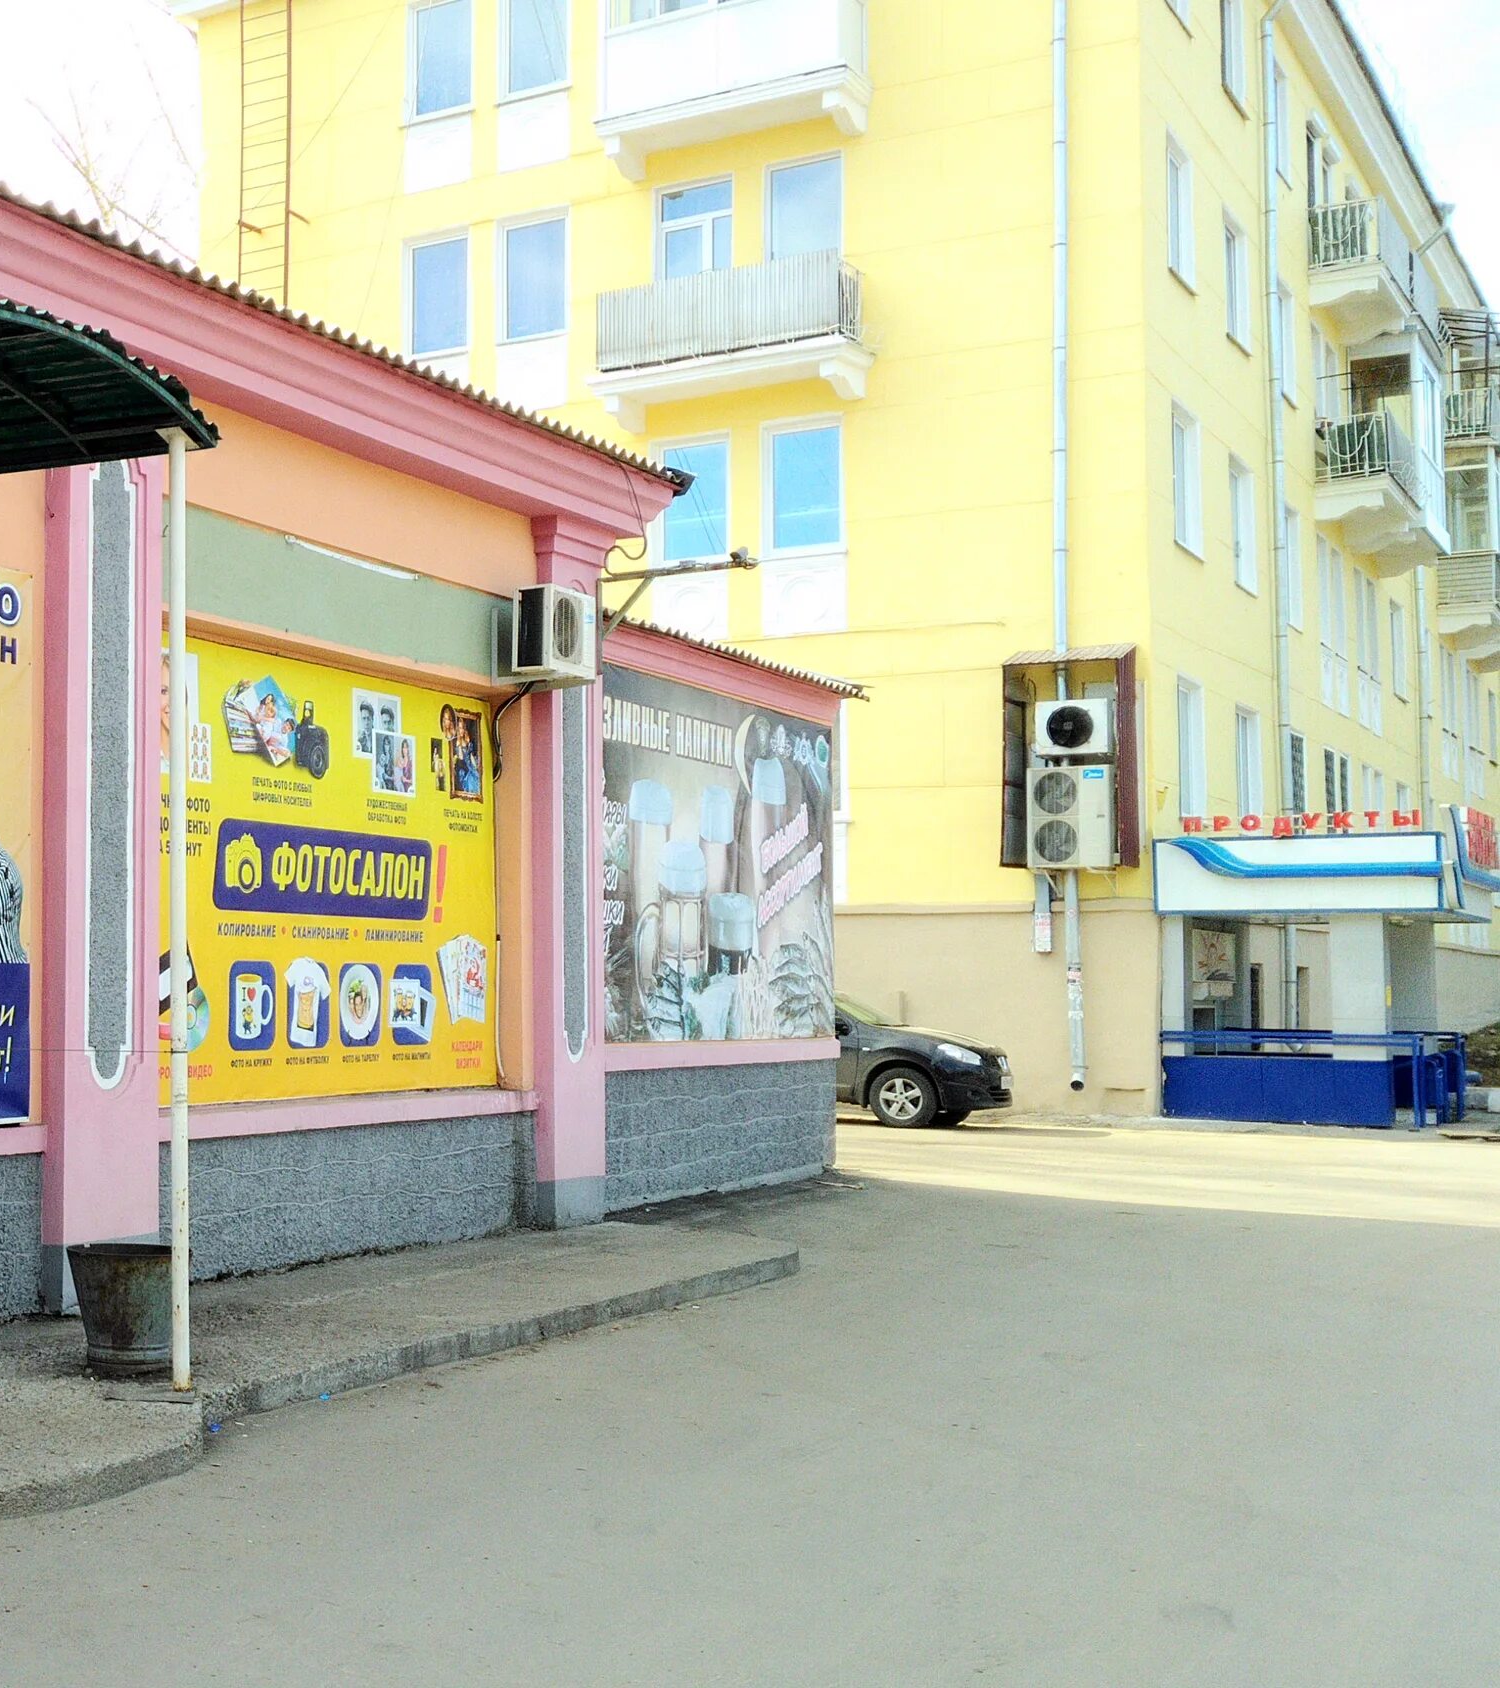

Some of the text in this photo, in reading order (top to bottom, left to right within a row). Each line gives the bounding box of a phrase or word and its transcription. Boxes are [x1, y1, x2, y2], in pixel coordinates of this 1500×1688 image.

[676, 714, 733, 768] НАПИТКИ
[273, 780, 288, 791] ФОТО
[186, 796, 211, 813] ФОТО
[1182, 809, 1420, 839] ПРОДУКТЫ
[271, 842, 426, 900] ФОТОСАЛОН
[217, 922, 424, 944] КОПИРОВАНИЕ СКАНИРОВАНИЕ ЛАМИНИРОВАНИЕ
[187, 1064, 213, 1080] ВИДЕО
